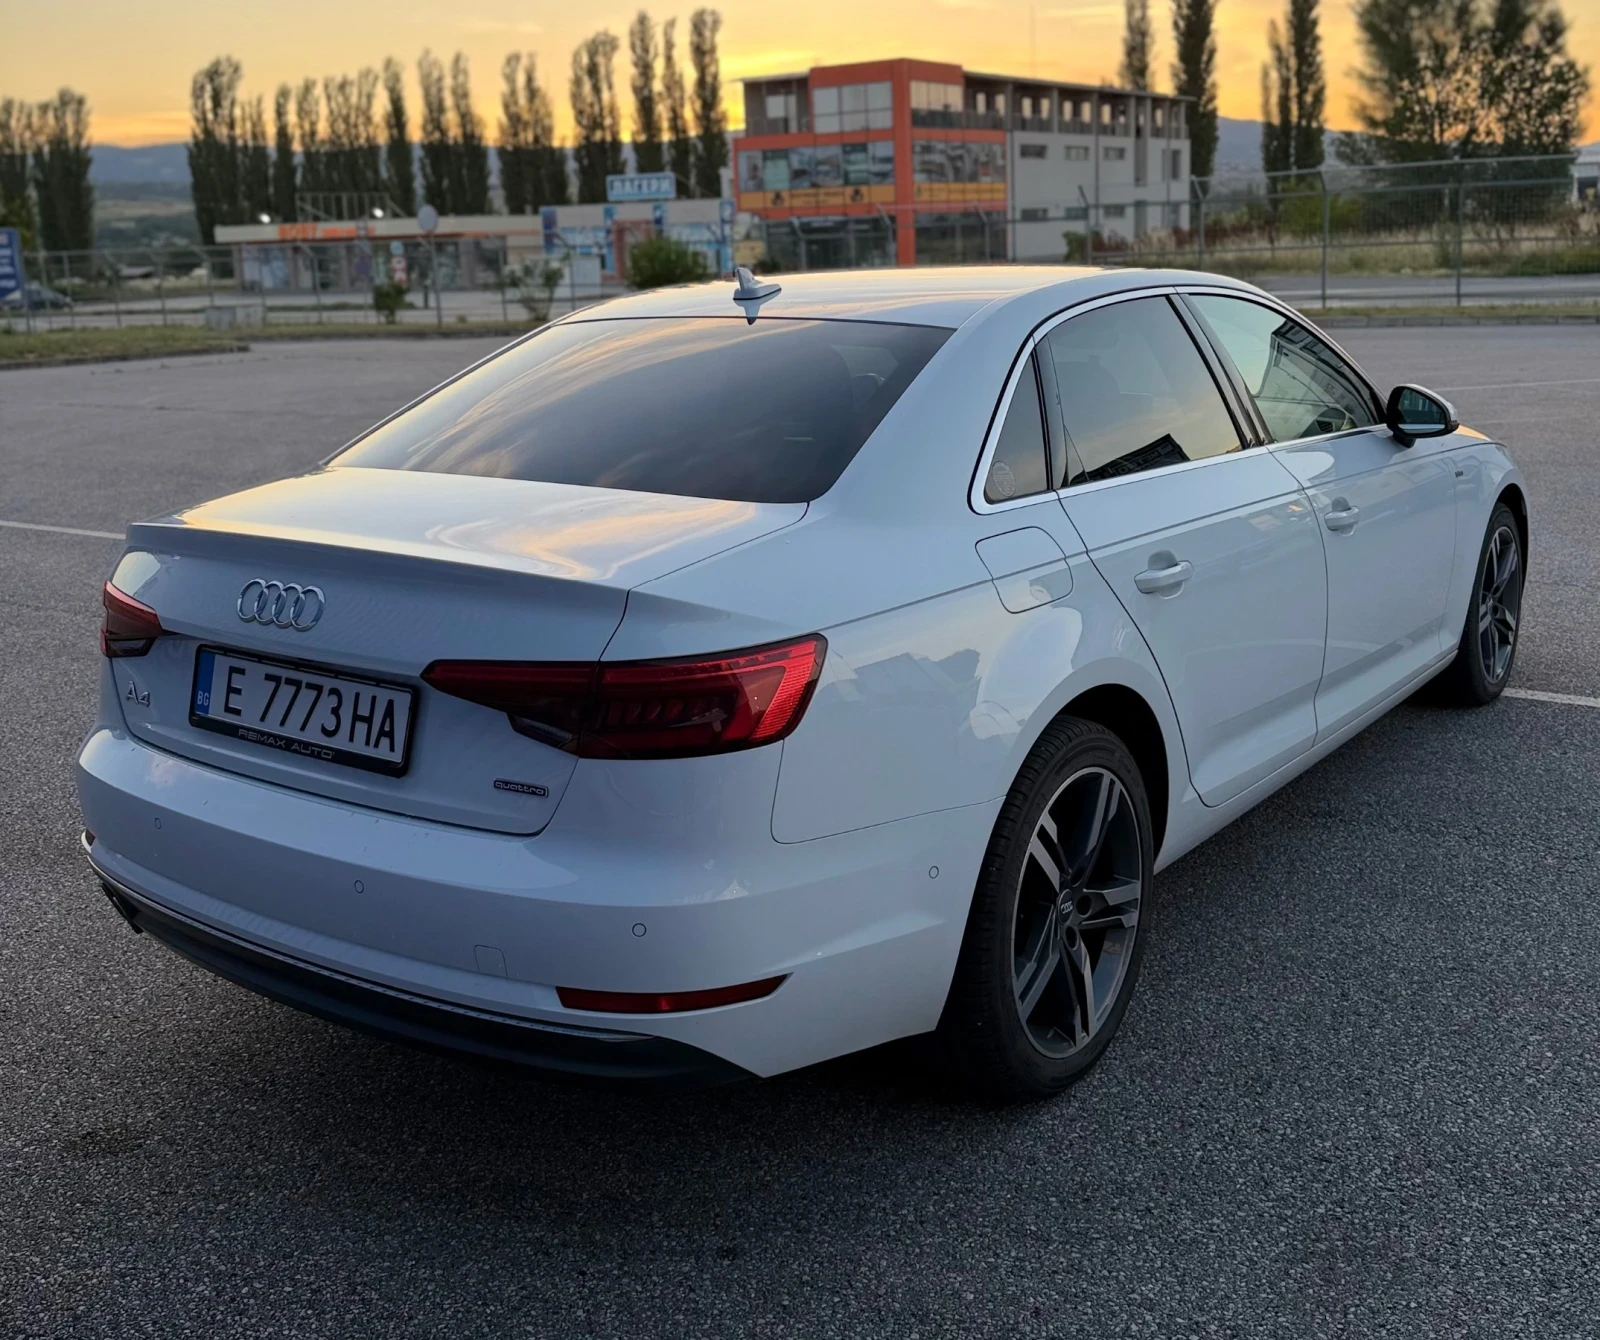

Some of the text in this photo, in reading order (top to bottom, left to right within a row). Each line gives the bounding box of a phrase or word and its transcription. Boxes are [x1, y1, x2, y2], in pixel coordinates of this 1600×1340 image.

[127, 681, 150, 707] A4
[197, 690, 210, 706] BG
[224, 666, 246, 716] E
[238, 728, 286, 748] REMAX
[495, 781, 544, 795] quattro
